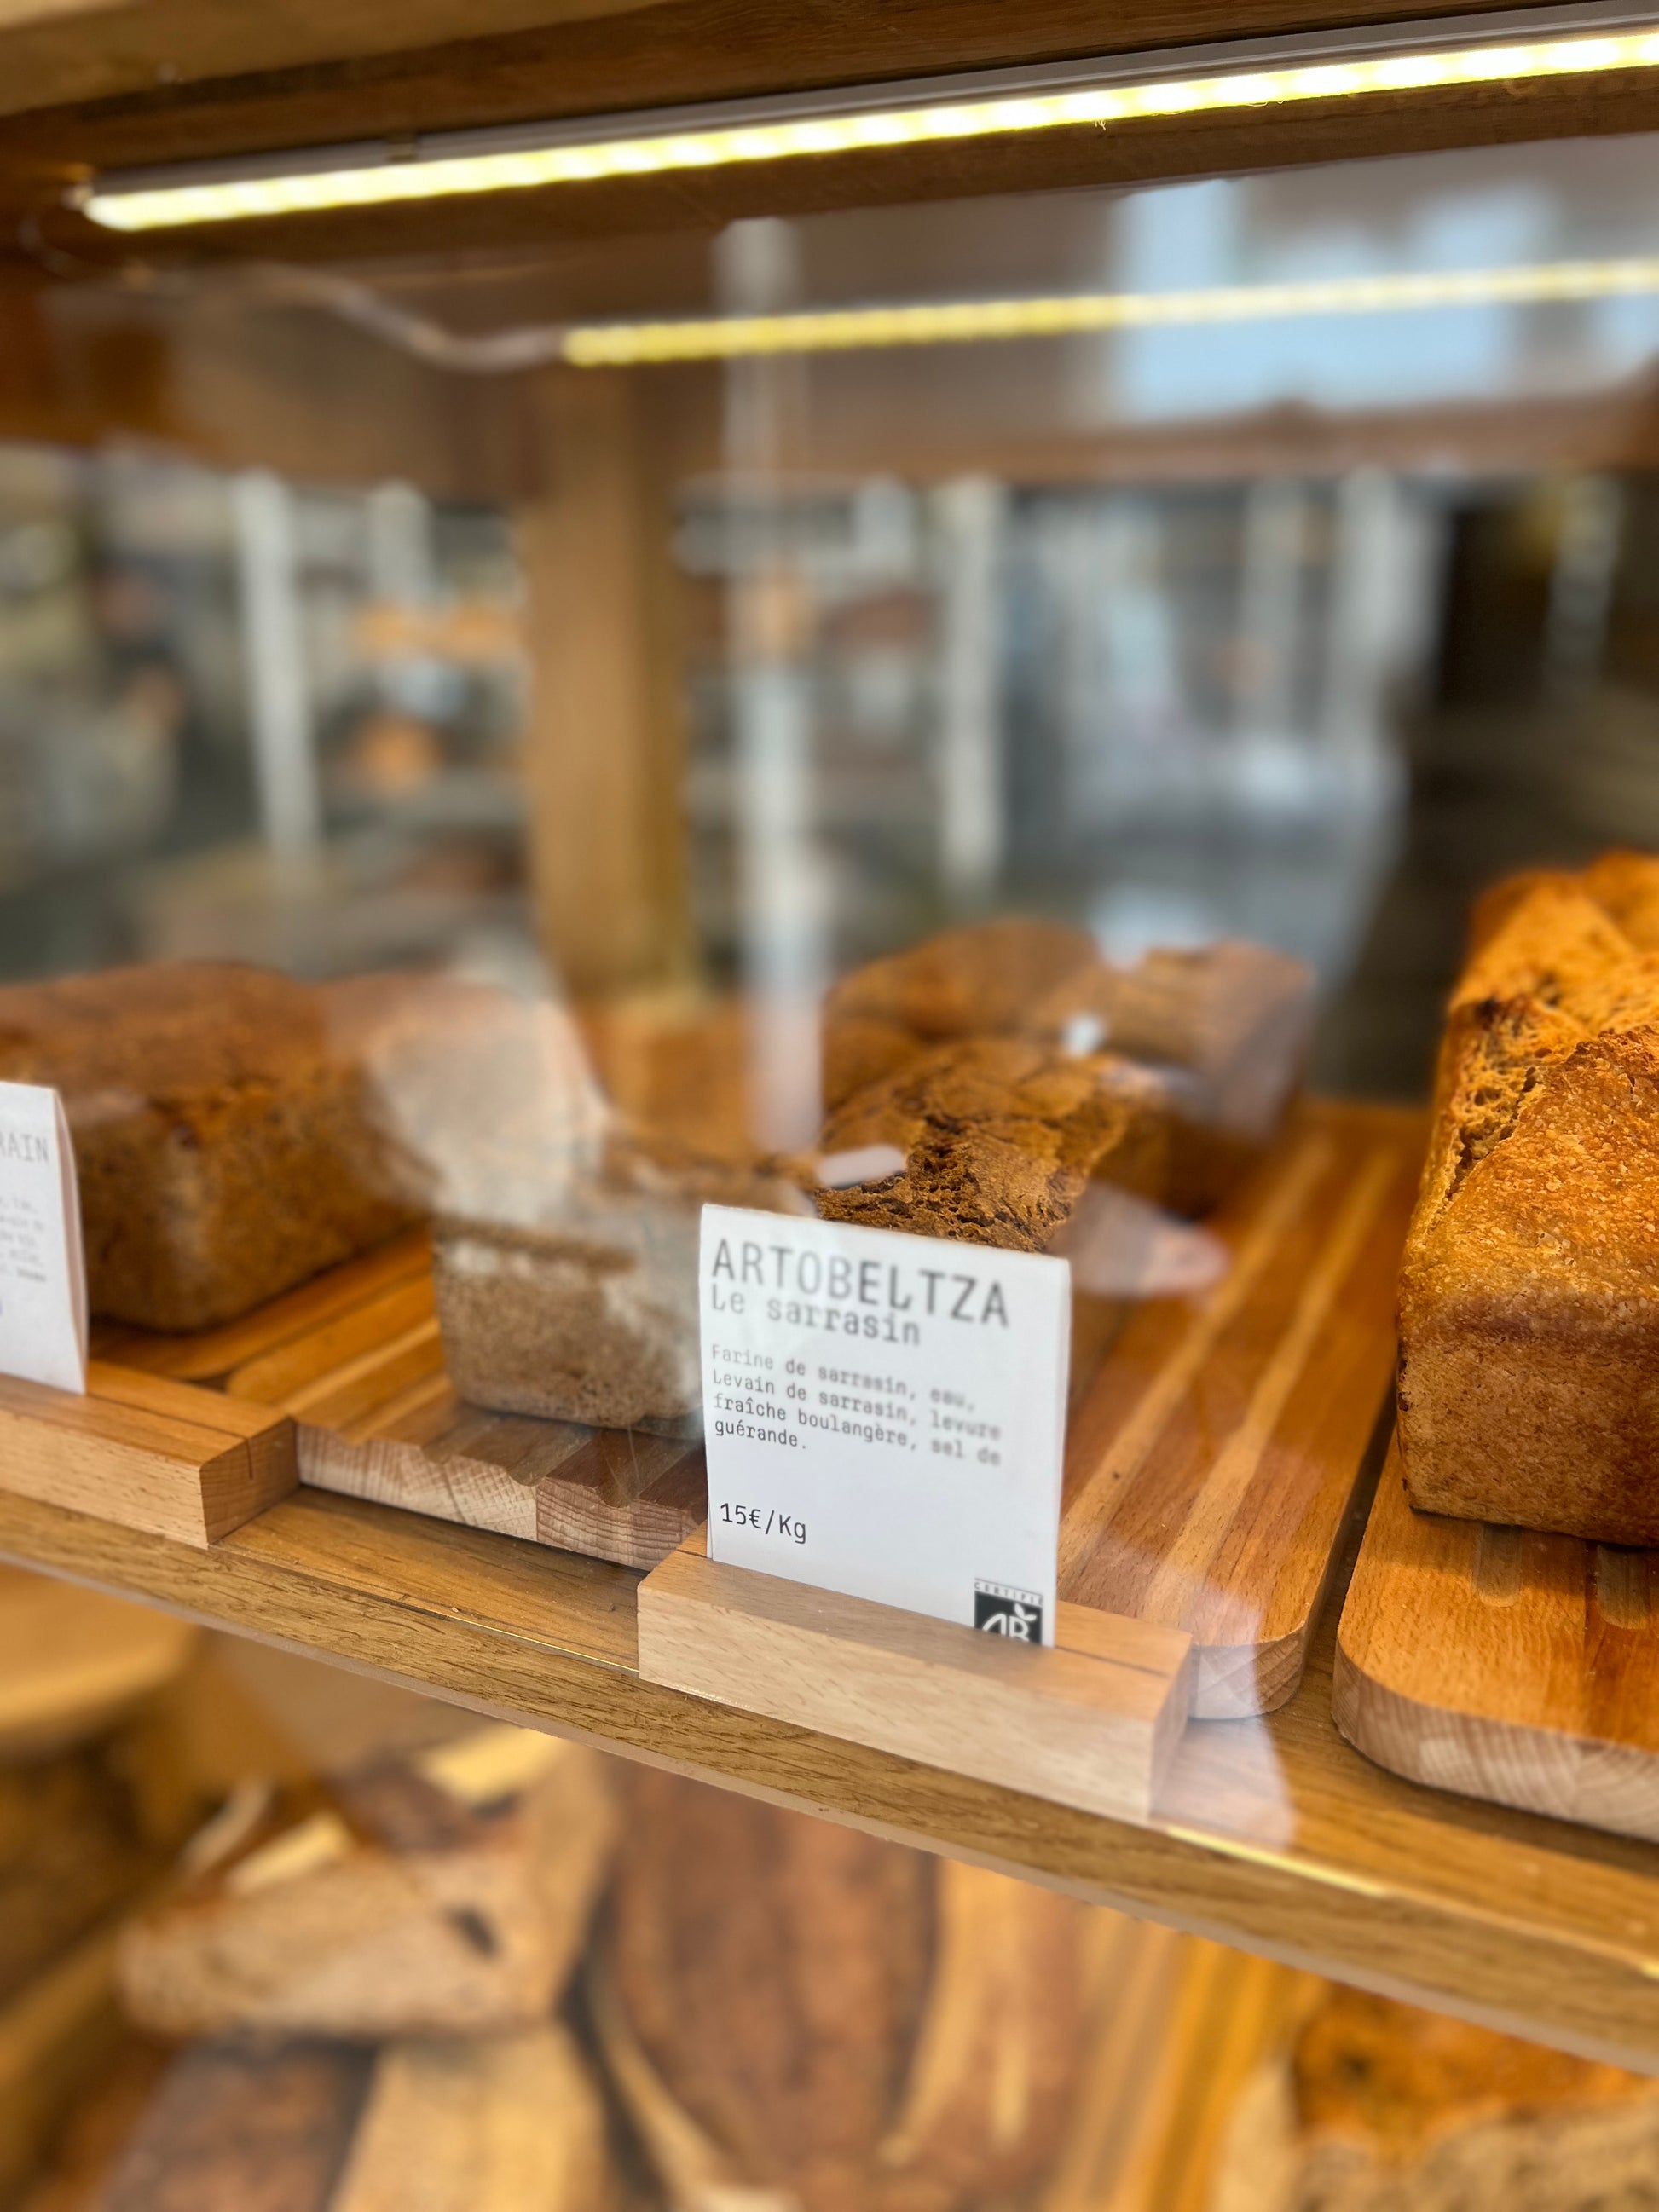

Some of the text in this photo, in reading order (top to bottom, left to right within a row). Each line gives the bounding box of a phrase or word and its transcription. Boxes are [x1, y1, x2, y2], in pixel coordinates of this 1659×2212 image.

[712, 1238, 1009, 1329] ARTOBELTZA
[712, 1283, 921, 1347] Le sarrasin
[712, 1344, 975, 1412] Farine de sarrasin, eau,
[713, 1368, 1002, 1441] Levain de sarrasin, levure
[714, 1393, 1002, 1467] fraîche boulangère, sel de
[714, 1419, 806, 1450] guérande.
[720, 1502, 806, 1545] 15€/Kg
